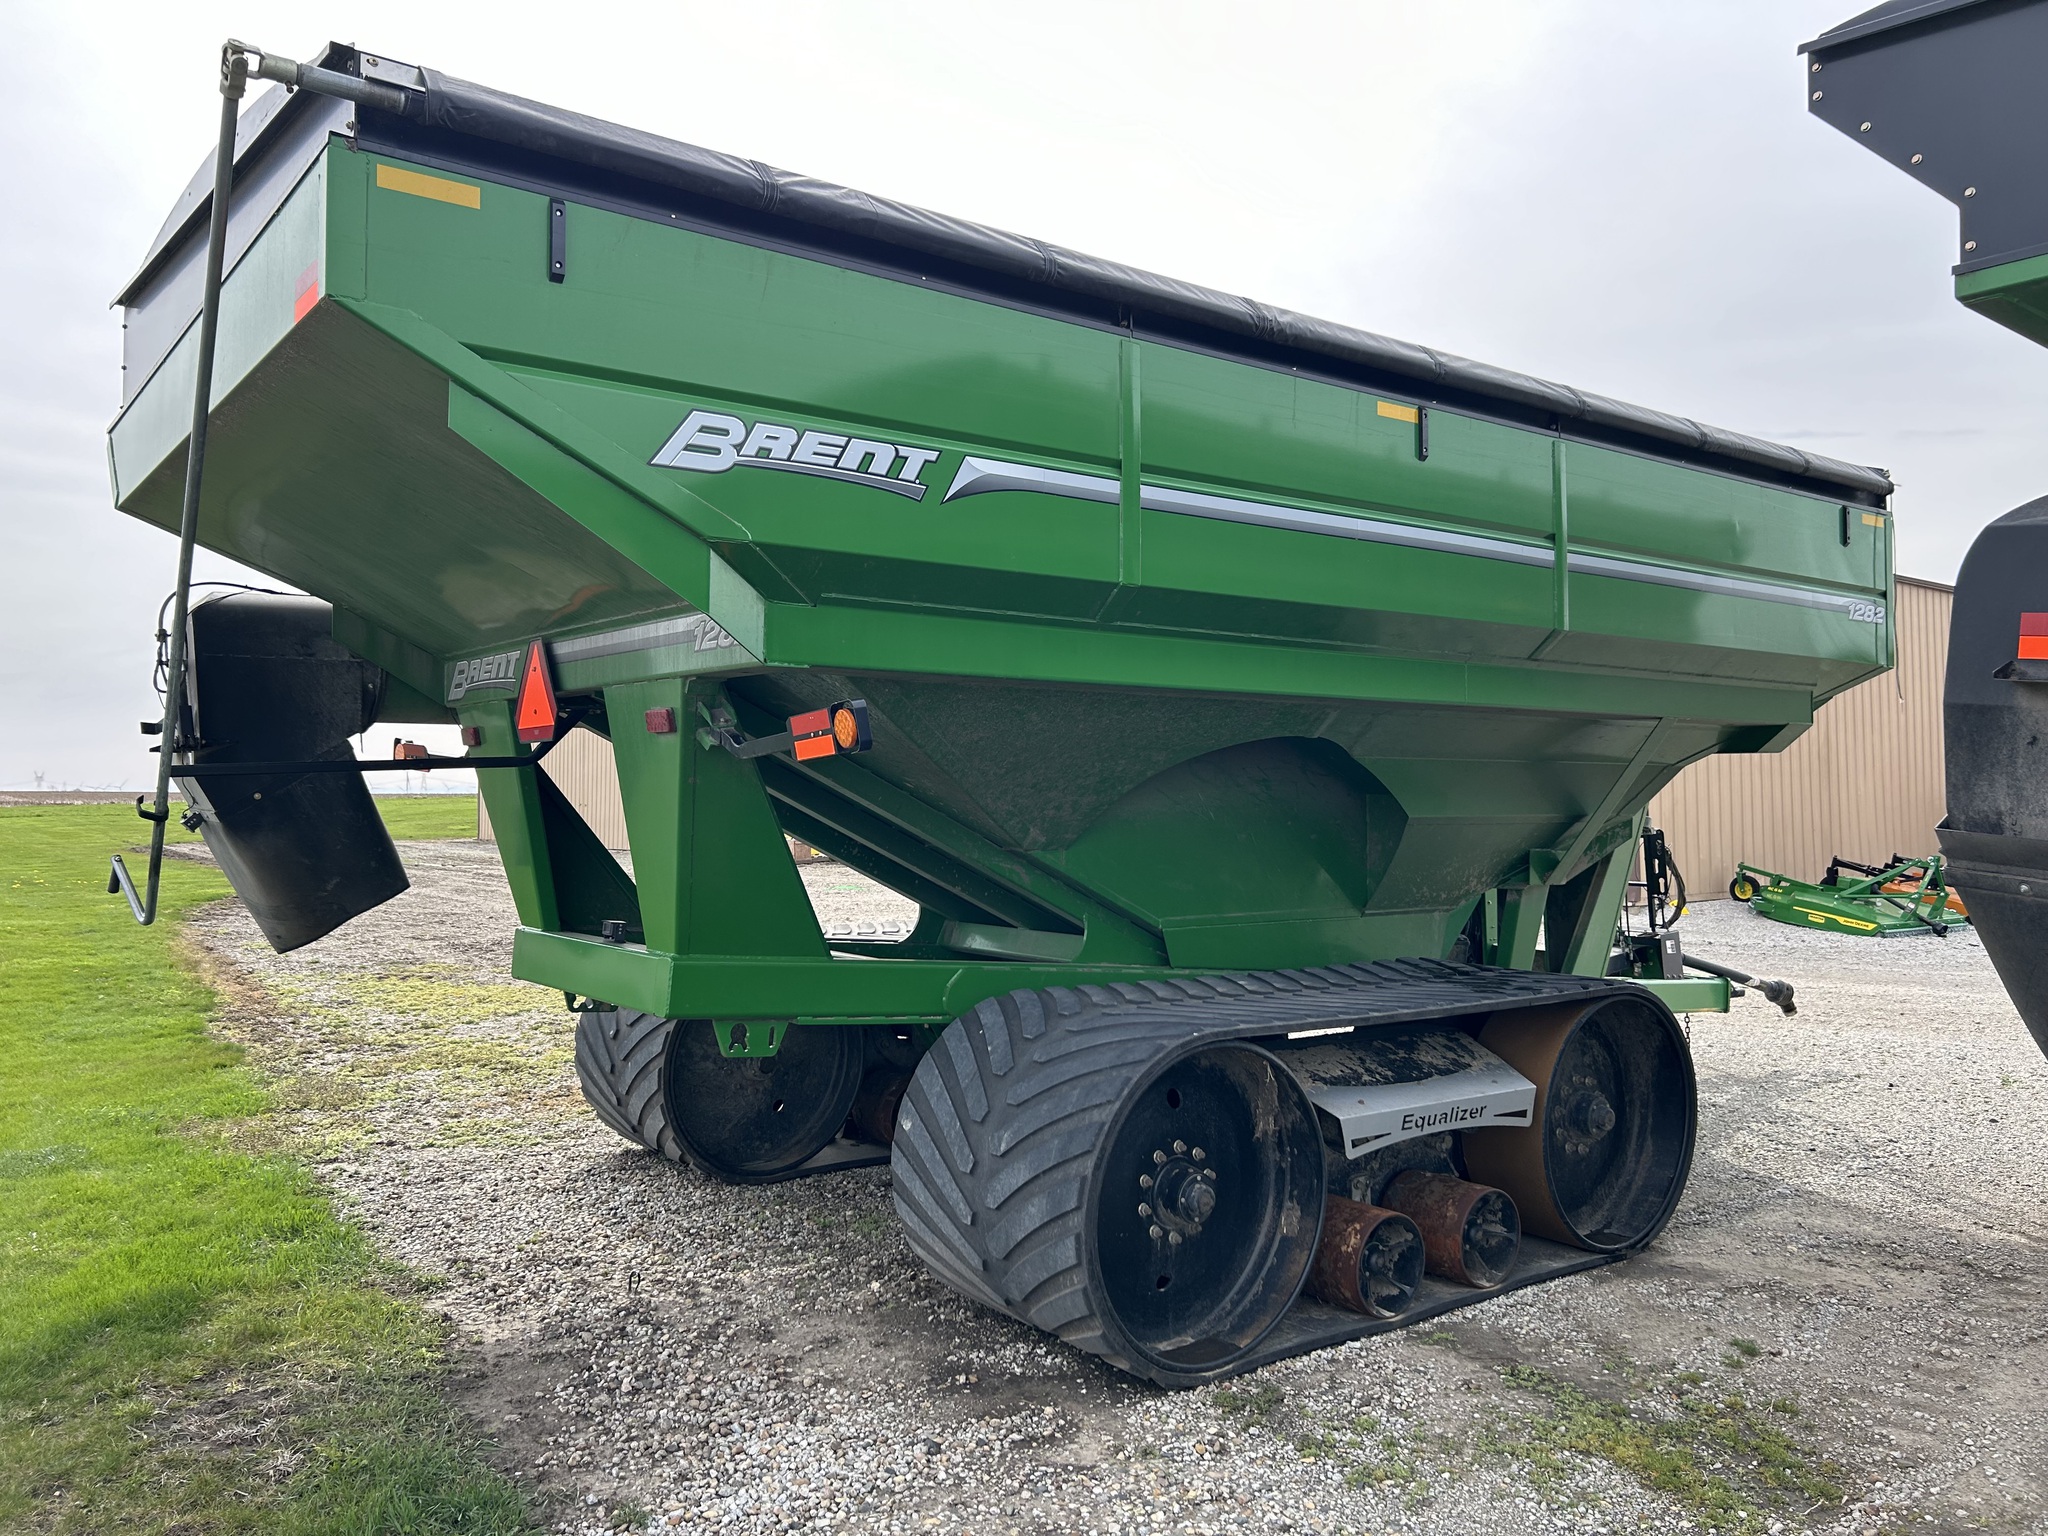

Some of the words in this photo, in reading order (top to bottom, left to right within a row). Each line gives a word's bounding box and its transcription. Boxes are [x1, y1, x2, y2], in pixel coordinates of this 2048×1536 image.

[648, 409, 941, 484] BRENT
[1848, 603, 1885, 624] 1282
[694, 619, 740, 652] 128
[448, 650, 521, 701] BRENT
[1401, 1105, 1487, 1132] Equalizer
